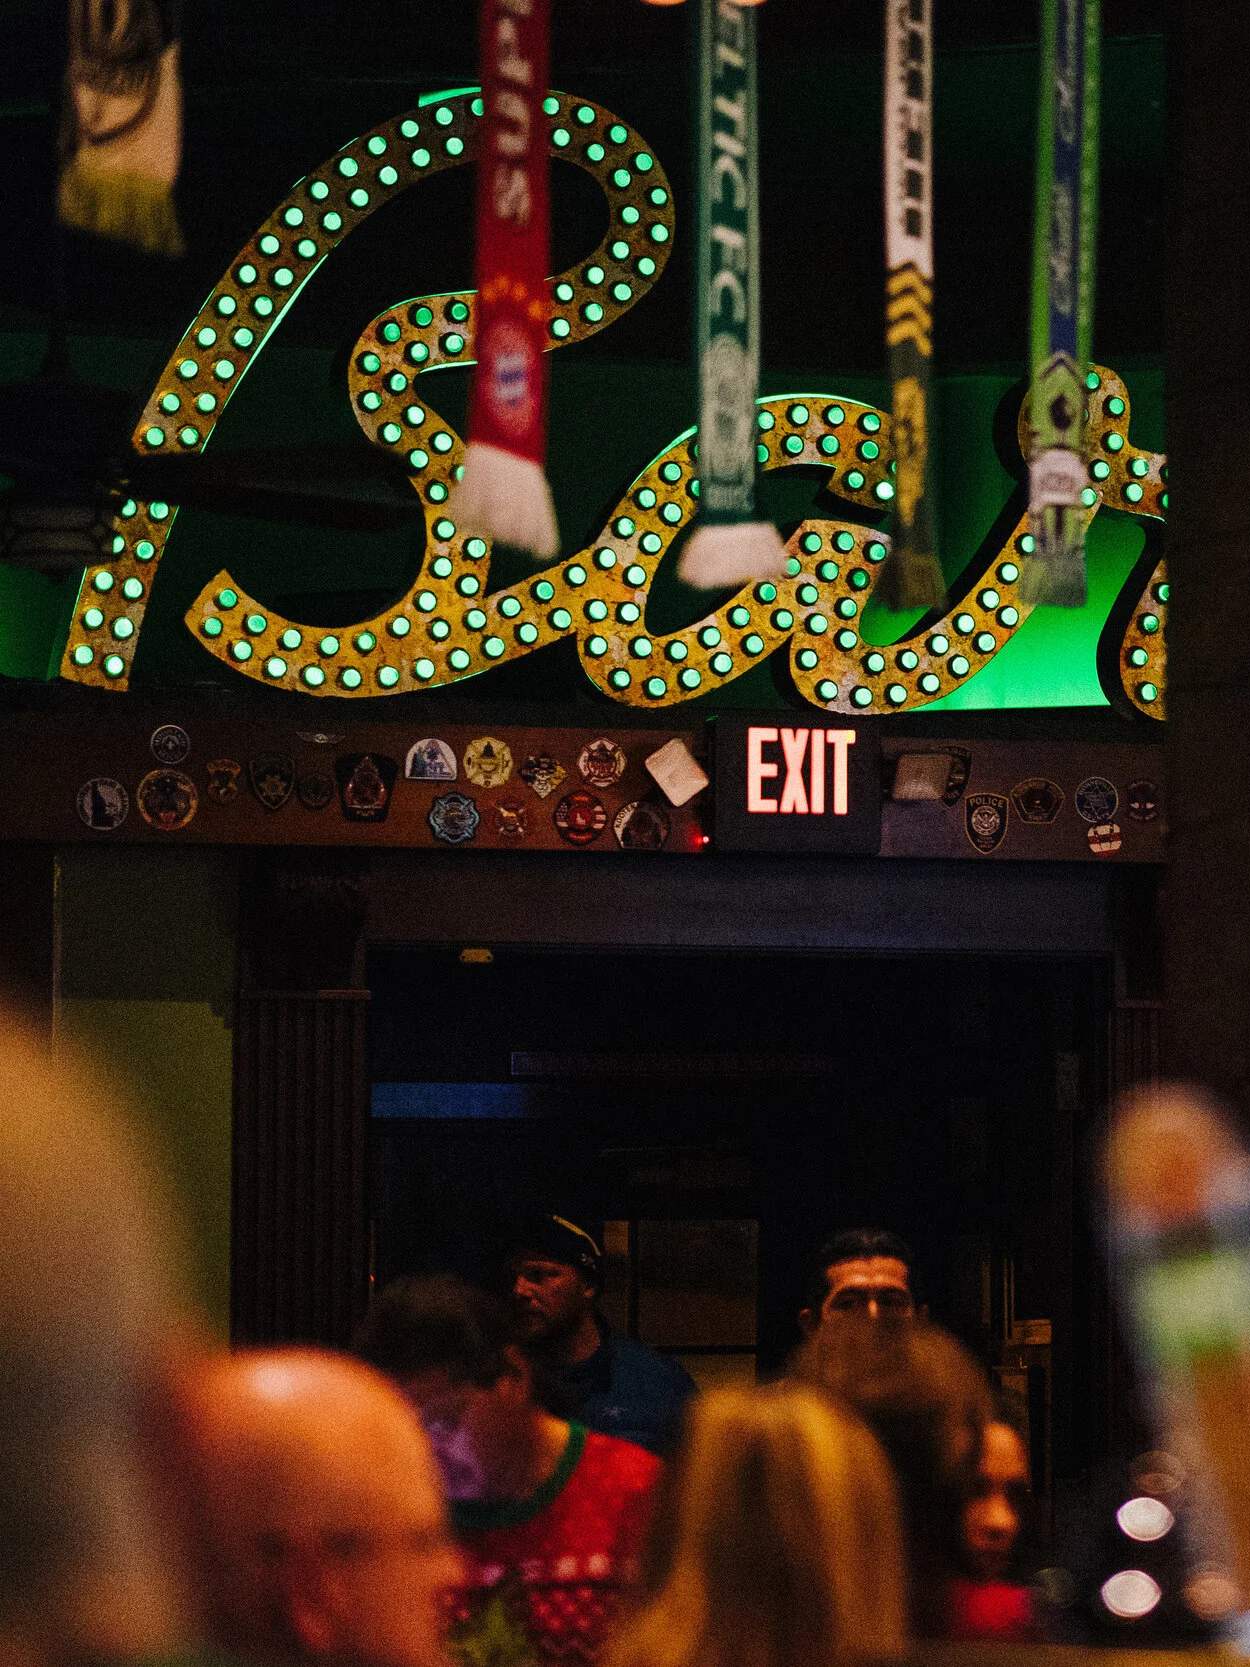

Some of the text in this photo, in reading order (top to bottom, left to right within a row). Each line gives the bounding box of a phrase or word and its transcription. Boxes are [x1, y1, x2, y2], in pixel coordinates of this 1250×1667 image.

[710, 225, 747, 321] FC
[747, 726, 856, 815] EXIT
[969, 797, 1005, 808] POLICE
